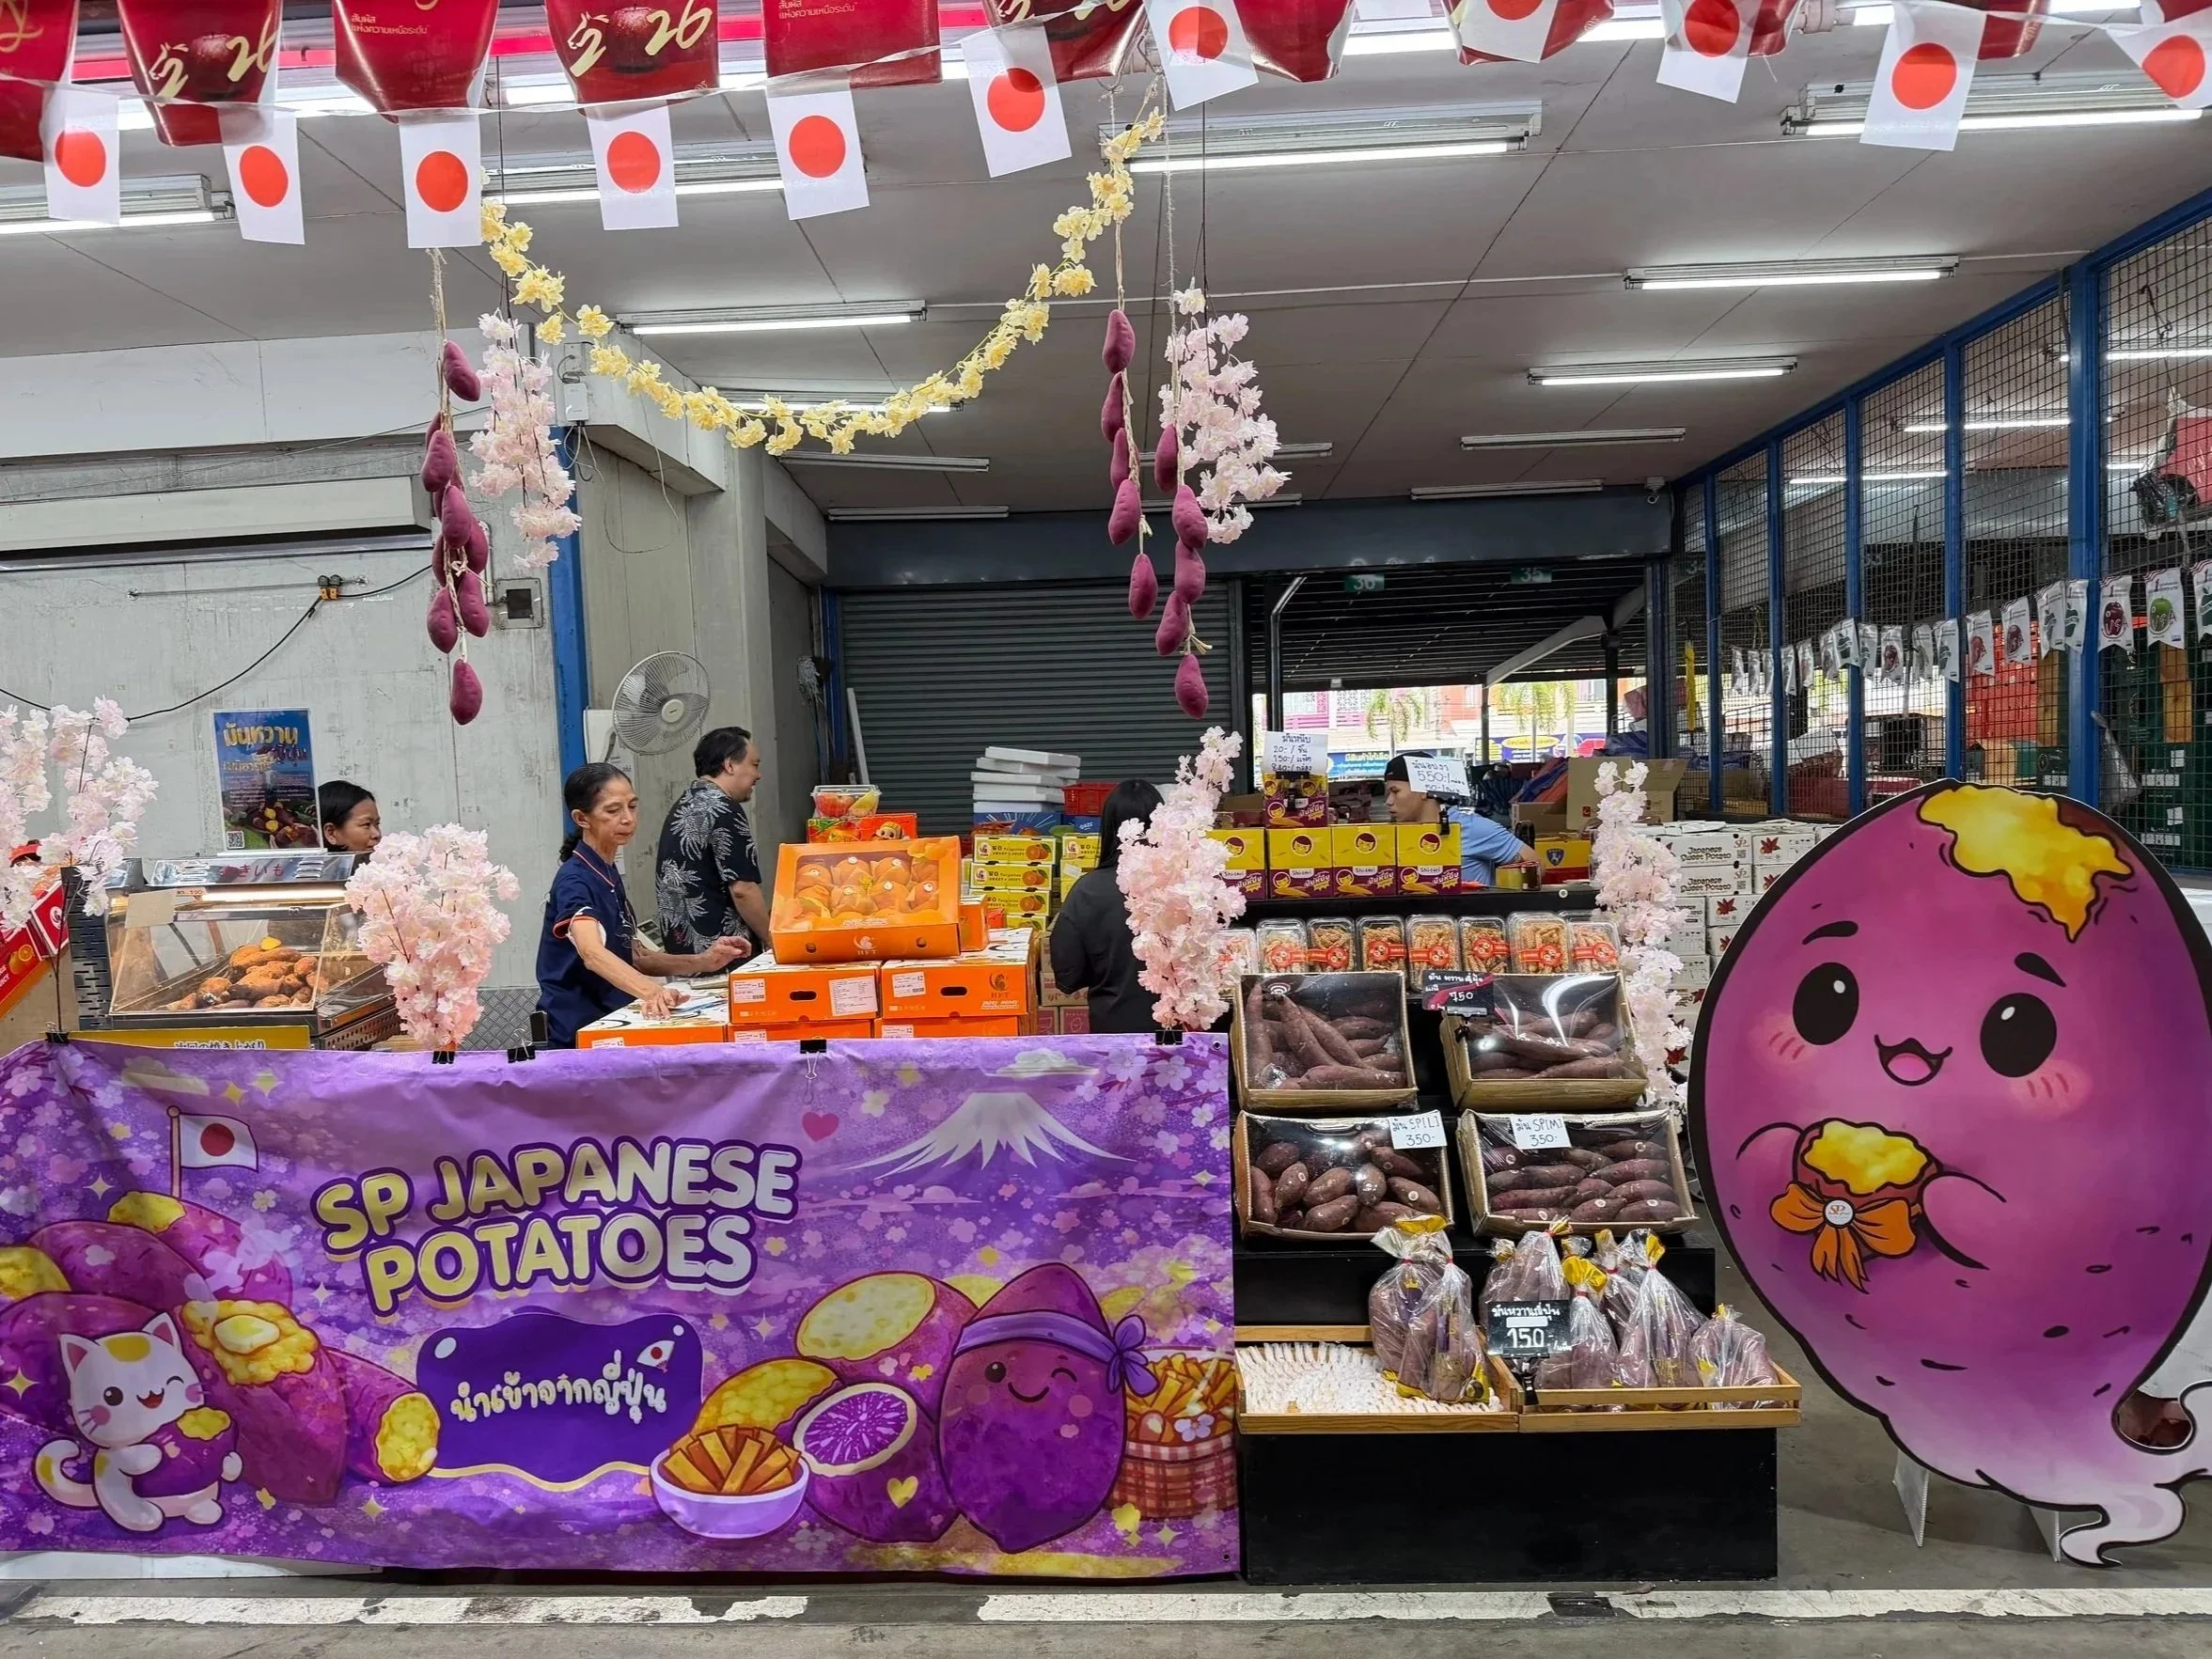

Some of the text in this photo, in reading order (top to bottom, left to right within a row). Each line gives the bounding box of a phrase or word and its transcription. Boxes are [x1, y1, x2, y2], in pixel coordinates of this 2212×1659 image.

[1520, 567, 1544, 582] 35
[223, 722, 298, 747] มันหวาน
[1687, 847, 1722, 855] Japanese
[1680, 854, 1703, 863] Sweet
[1705, 853, 1732, 861] Potato
[1687, 878, 1722, 886] Japanese
[1680, 885, 1703, 894] Sweet
[1705, 884, 1732, 892] Potato
[1392, 1119, 1408, 1132] มัน
[1515, 1119, 1531, 1132] มัน
[314, 1140, 801, 1252] SP JAPANESE
[365, 1213, 753, 1314] POTATOES
[450, 1350, 667, 1425] นำเข้าจากญี่ปุ่น
